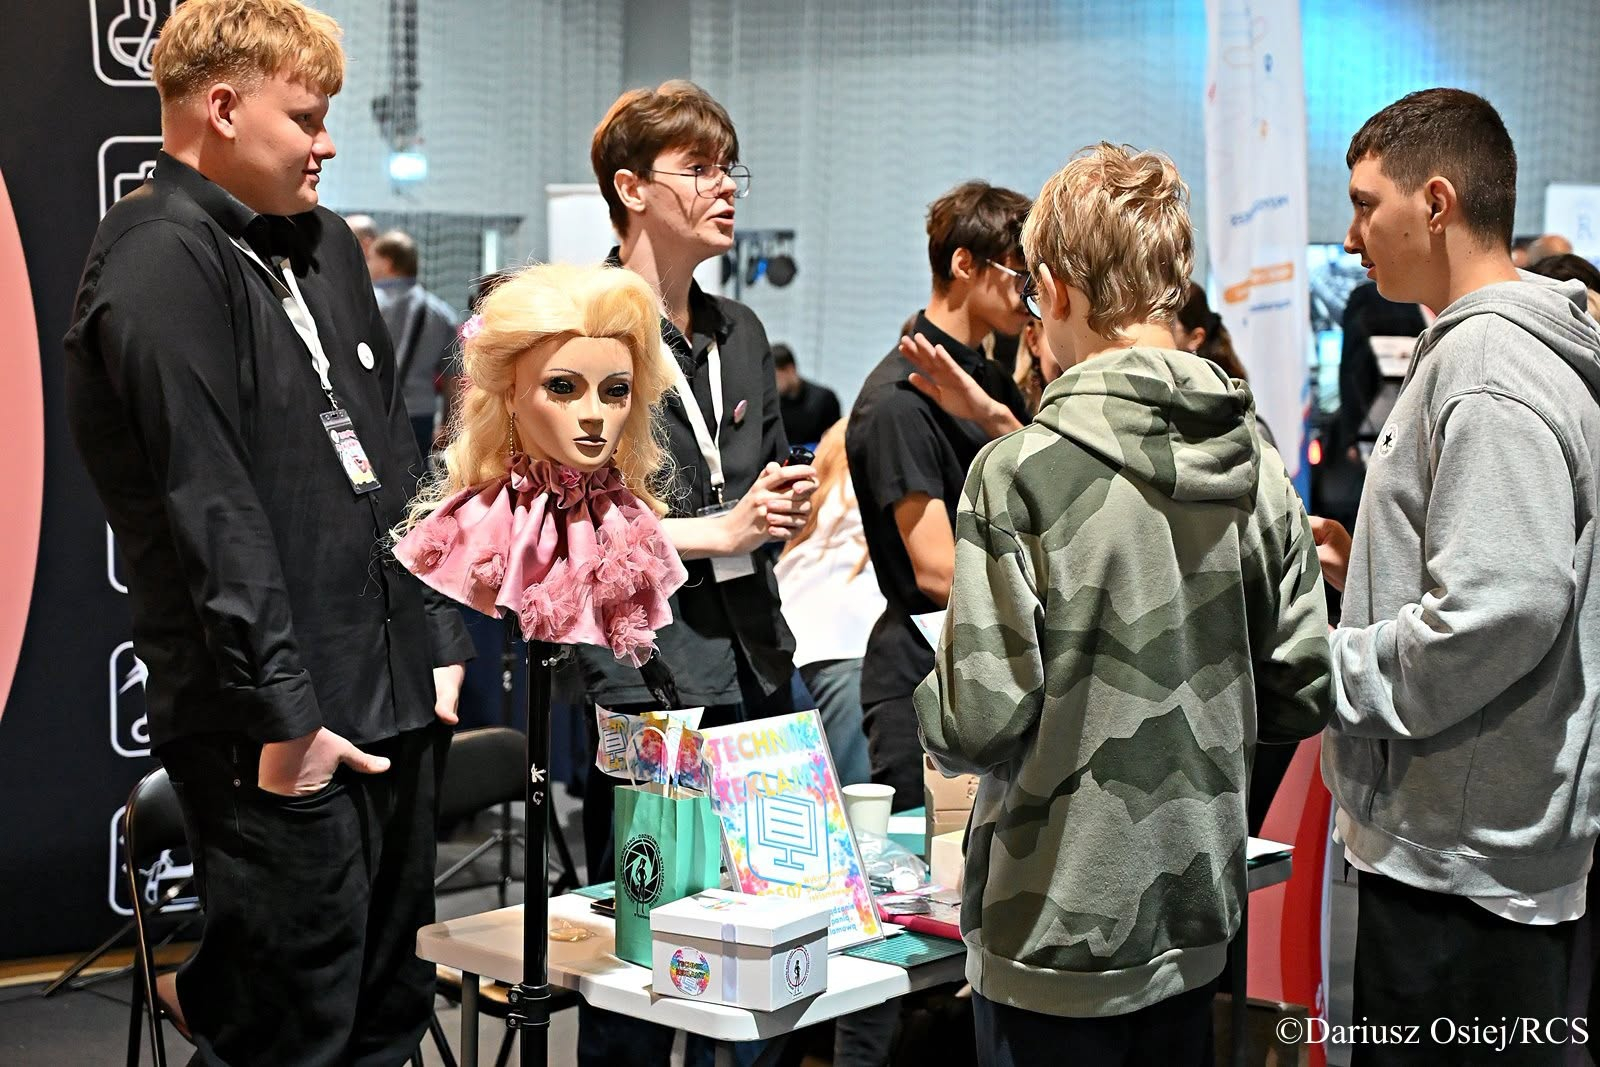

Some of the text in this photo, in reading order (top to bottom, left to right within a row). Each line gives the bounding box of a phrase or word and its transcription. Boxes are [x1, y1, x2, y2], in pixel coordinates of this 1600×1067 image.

[707, 723, 816, 765] TECHNIK
[713, 760, 826, 806] REKLAMY
[829, 923, 859, 935] lamową
[831, 915, 850, 927] panią
